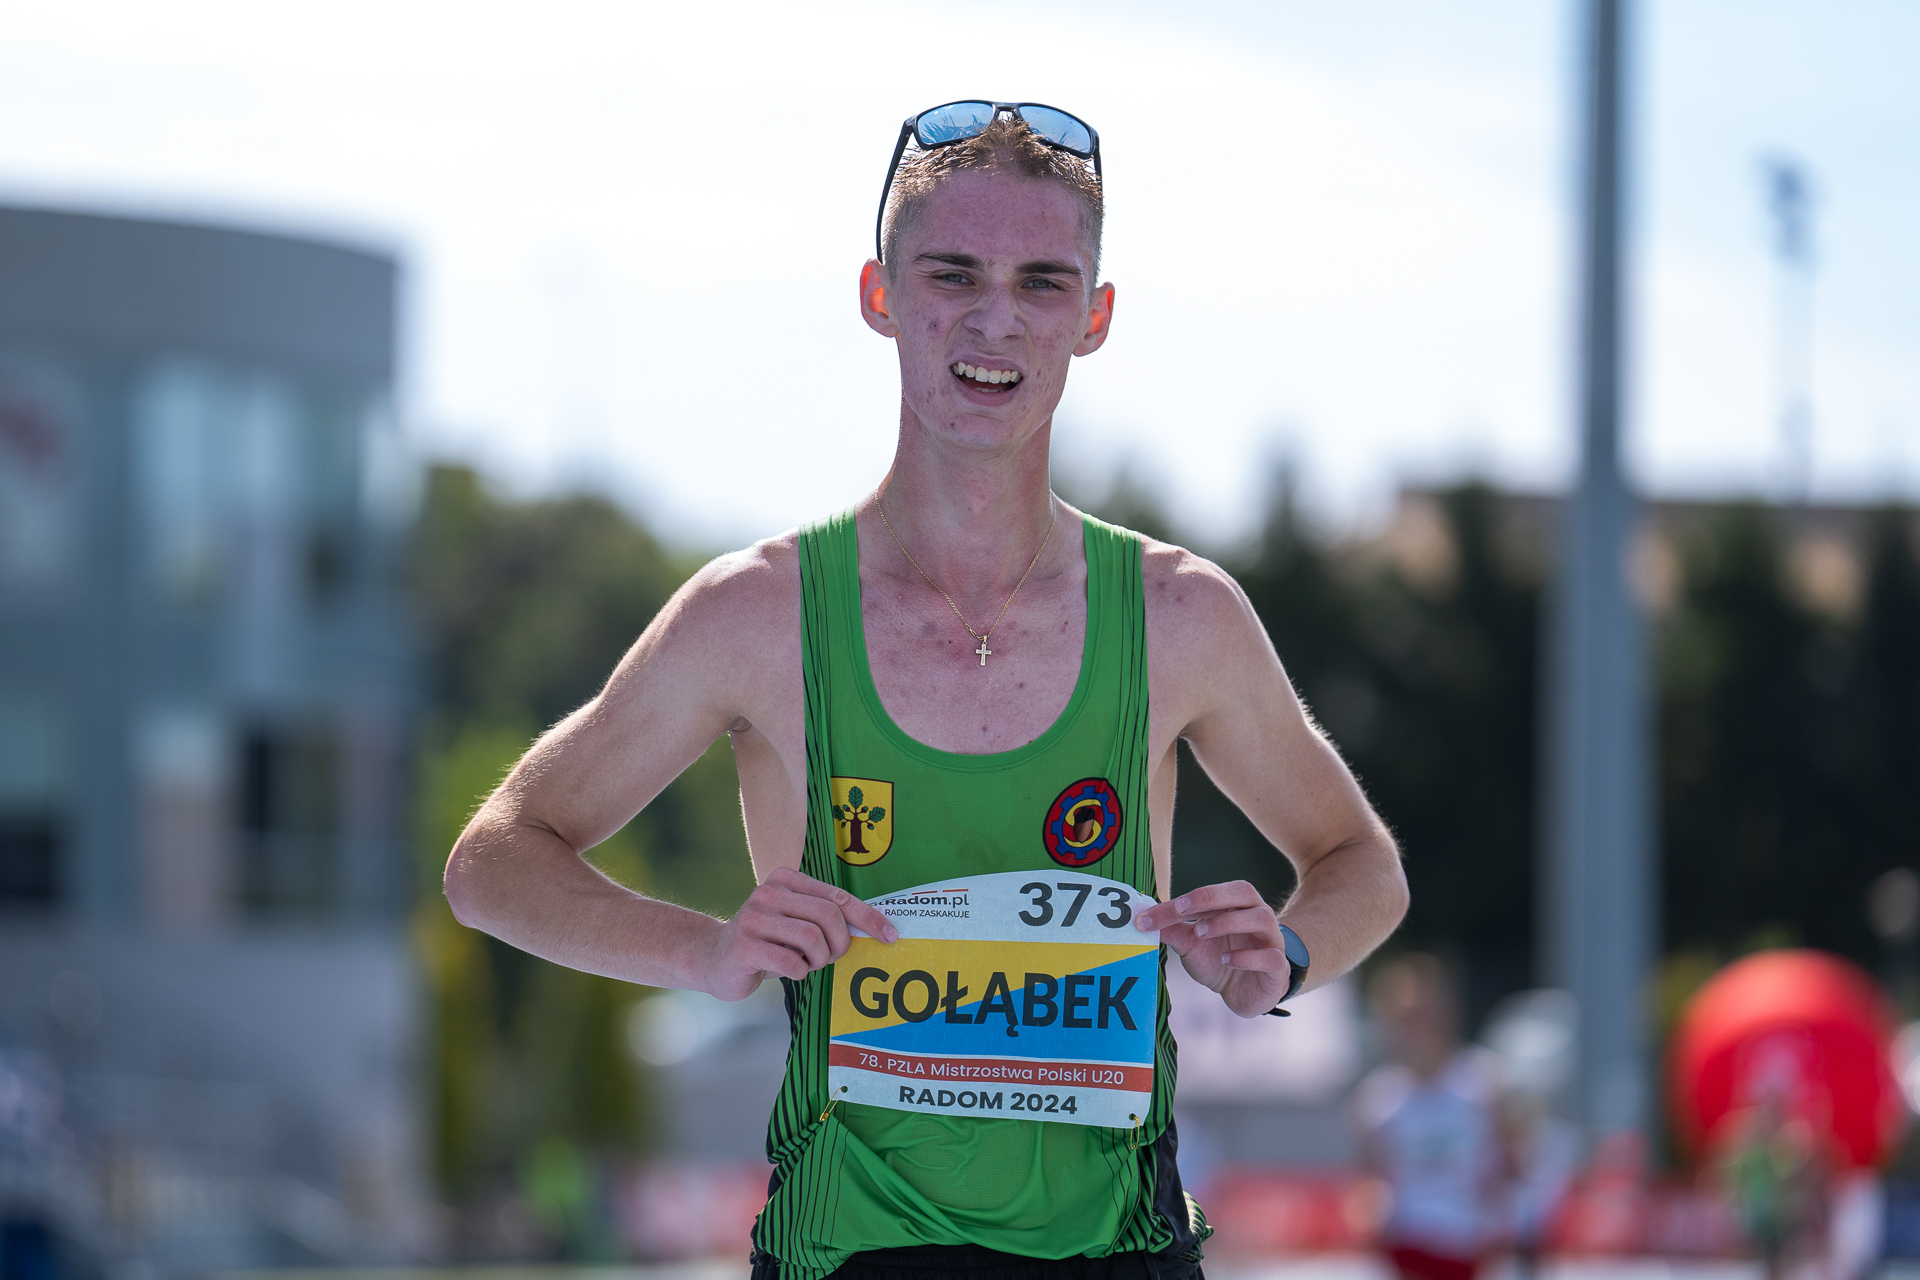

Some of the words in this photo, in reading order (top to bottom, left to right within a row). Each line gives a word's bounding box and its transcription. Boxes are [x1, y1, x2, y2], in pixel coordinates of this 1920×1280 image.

[885, 909, 917, 917] RADOM
[919, 910, 970, 918] ZASKAKUJE
[1018, 882, 1132, 928] 373
[850, 967, 1140, 1037] GOŁĄBEK
[859, 1053, 882, 1068] 78.
[887, 1058, 925, 1075] PZLA
[931, 1063, 1032, 1080] Mistrzostwa
[1038, 1068, 1087, 1082] Polski
[1092, 1070, 1124, 1085] U20
[899, 1085, 1003, 1109] RADOM
[1010, 1092, 1077, 1114] 2024
